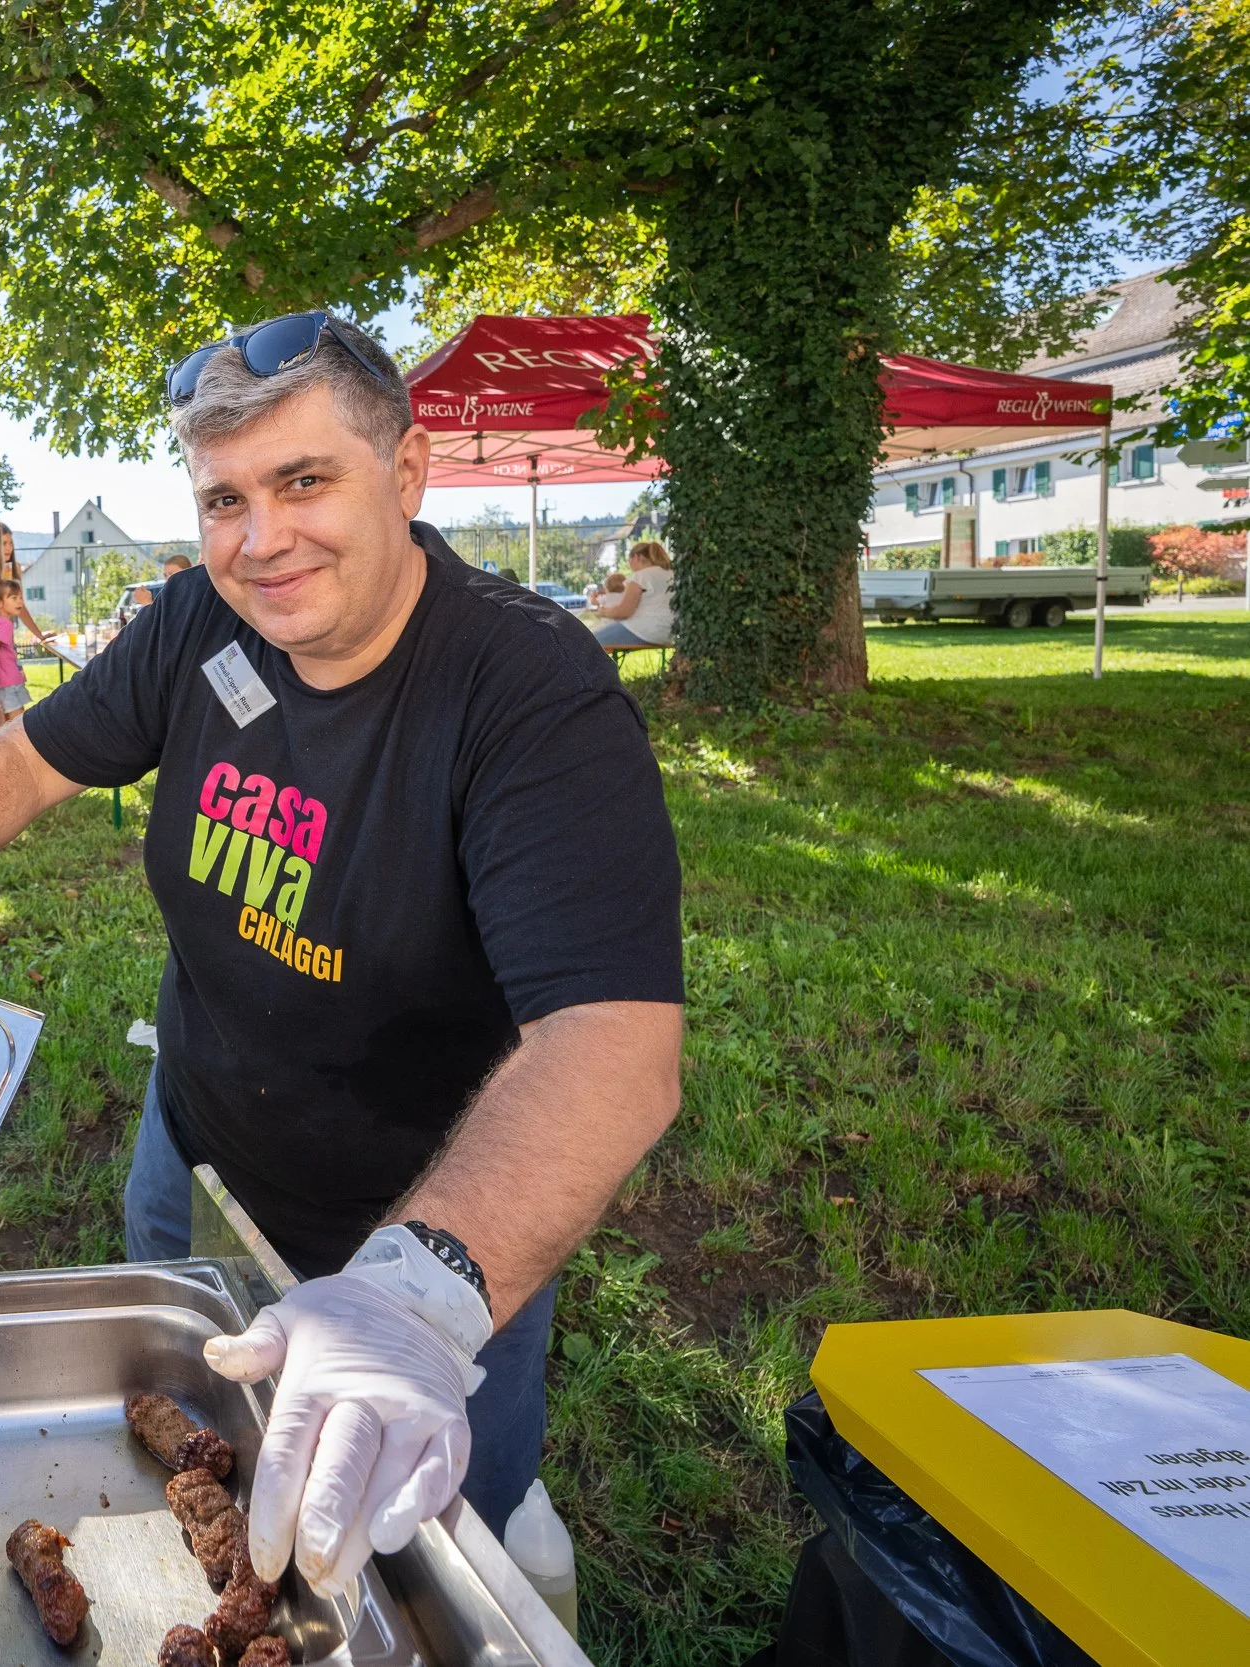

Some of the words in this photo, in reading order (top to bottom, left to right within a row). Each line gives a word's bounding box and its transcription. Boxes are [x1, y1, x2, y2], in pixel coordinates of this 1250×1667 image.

[418, 403, 461, 417] REGLI
[486, 402, 535, 416] WEINE
[997, 399, 1033, 413] REGLI
[240, 697, 252, 712] Rusu
[238, 905, 343, 983] CHLÄGGI
[1144, 1448, 1250, 1467] abgeben
[1098, 1480, 1161, 1497] Zelt
[1150, 1478, 1196, 1494] im
[1188, 1475, 1246, 1493] oder
[1150, 1503, 1249, 1519] Harass
